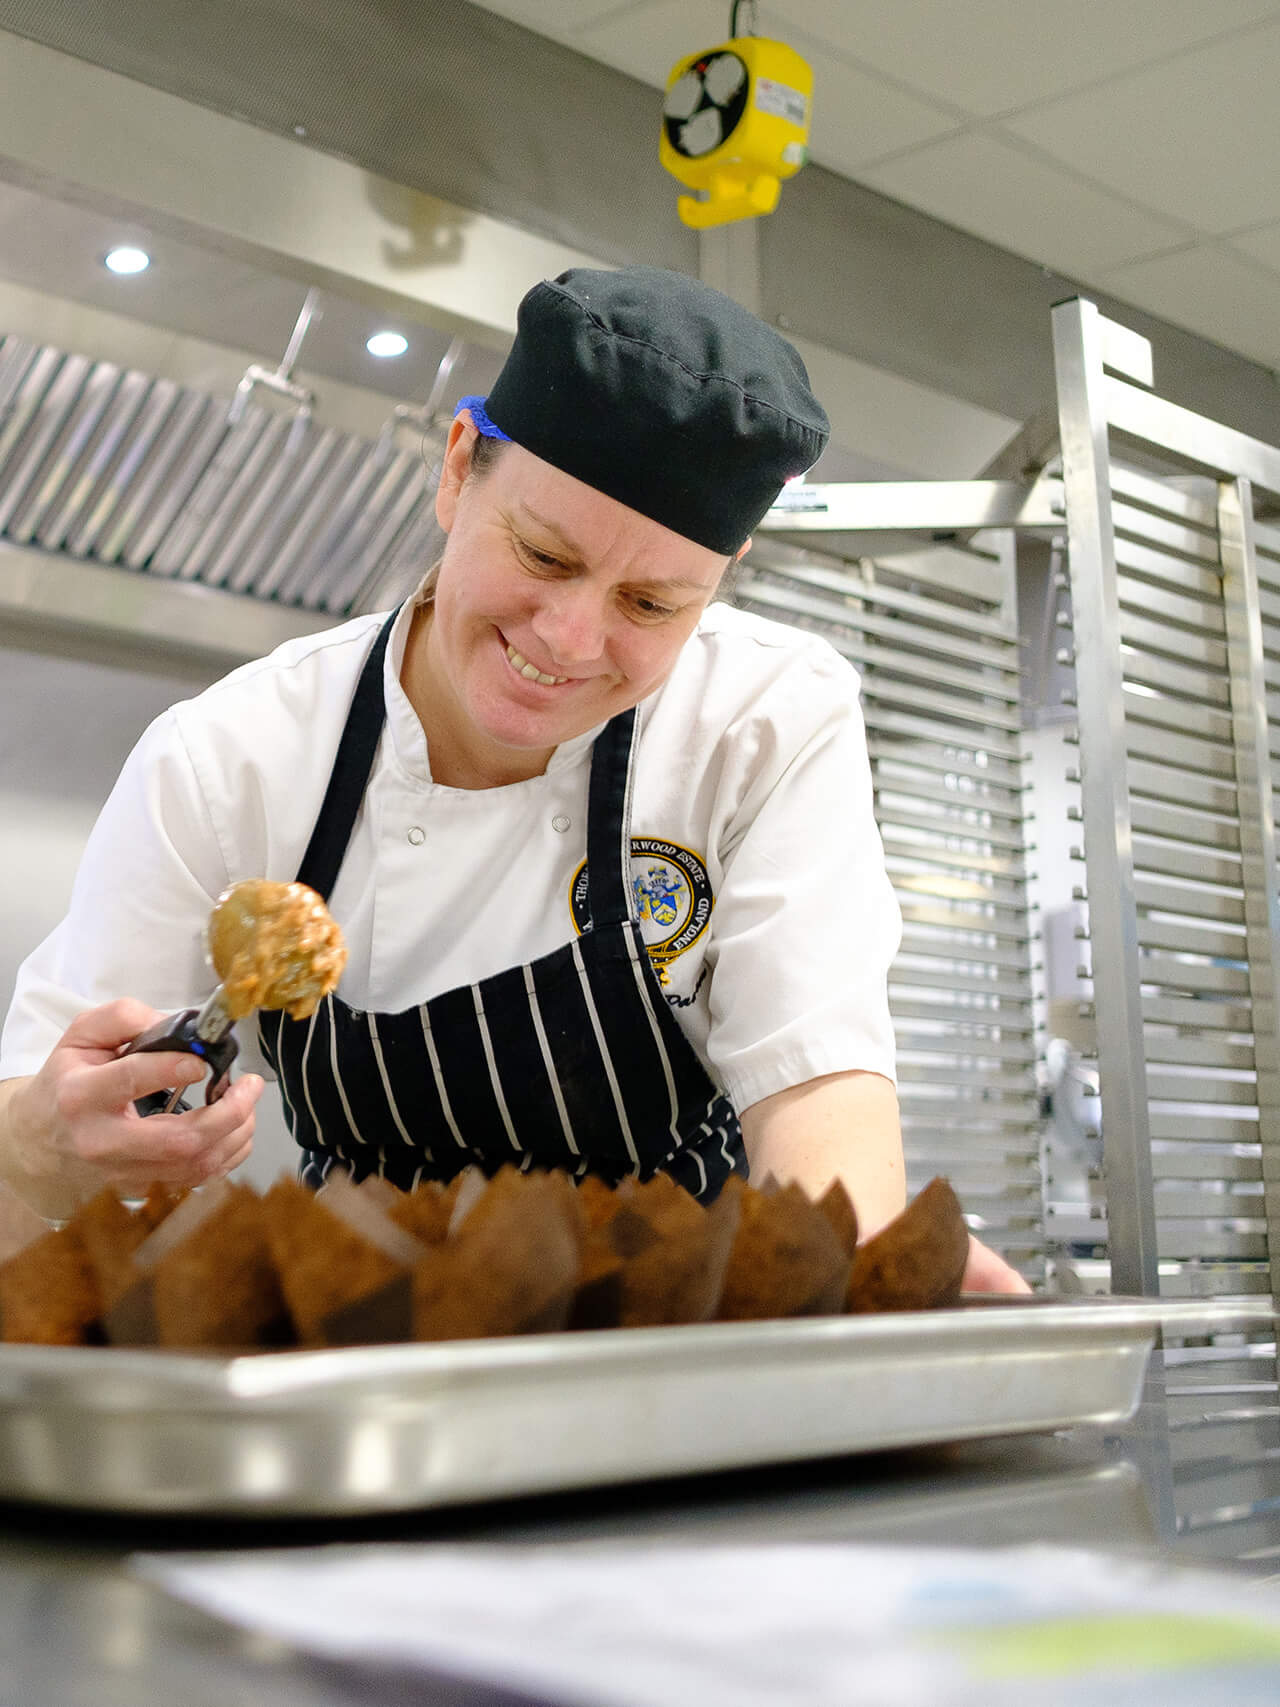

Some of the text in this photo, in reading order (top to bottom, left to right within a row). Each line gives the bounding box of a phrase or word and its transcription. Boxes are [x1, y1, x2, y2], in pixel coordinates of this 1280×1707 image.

[631, 841, 677, 856] RWOOD
[676, 851, 705, 882] ESTATE
[673, 898, 709, 950] ENGLAND
